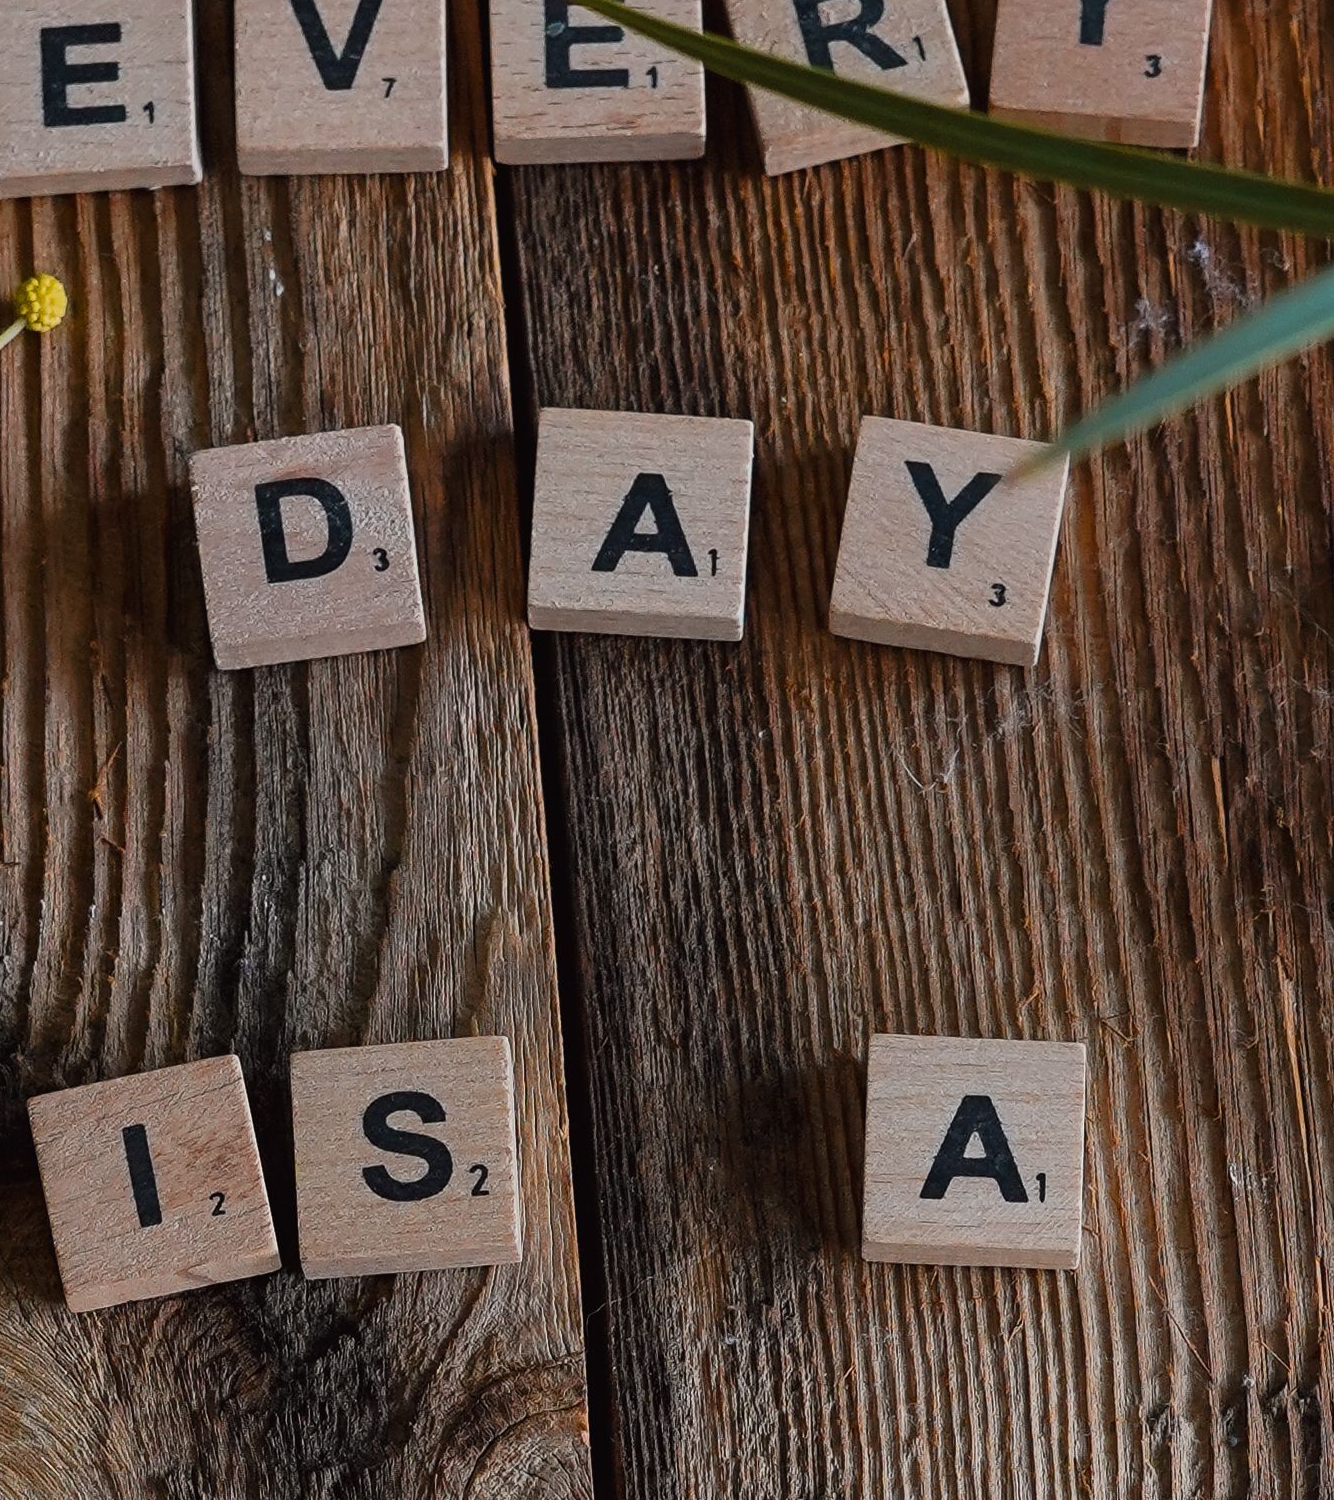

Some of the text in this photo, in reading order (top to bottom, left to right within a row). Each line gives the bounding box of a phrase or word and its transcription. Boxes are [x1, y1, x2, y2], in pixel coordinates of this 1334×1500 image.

[913, 36, 925, 60] 1
[646, 67, 657, 88] 1
[1144, 55, 1161, 78] 3
[382, 78, 396, 98] 7
[143, 102, 154, 123] 1
[254, 460, 1002, 584] DAY
[373, 548, 389, 571] 3
[709, 549, 718, 576] 1
[989, 584, 1006, 607] 3
[122, 1091, 1029, 1228] IS A
[469, 1164, 489, 1196] 2
[1036, 1173, 1046, 1202] 1
[209, 1192, 225, 1216] 2
